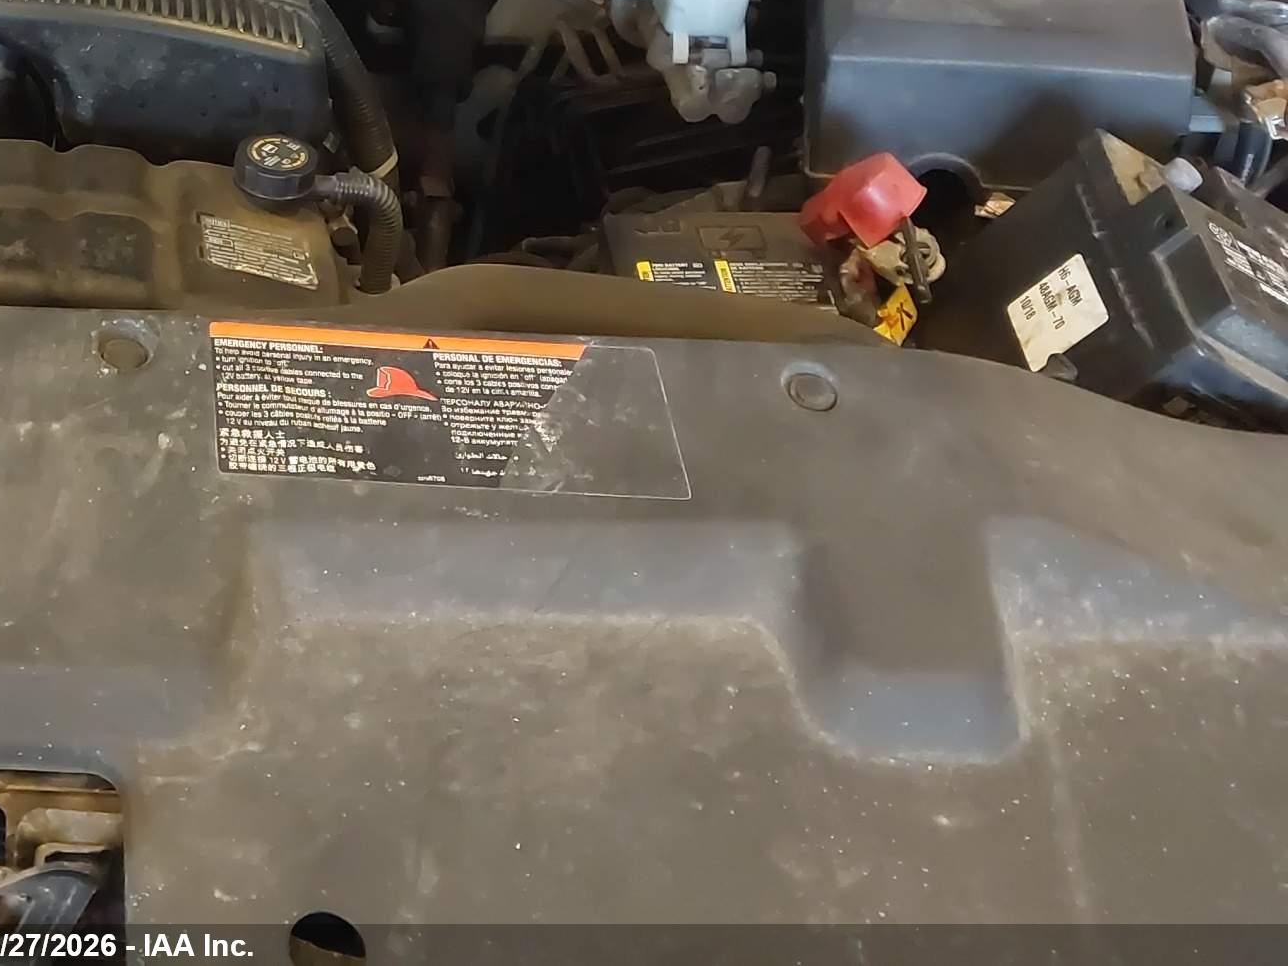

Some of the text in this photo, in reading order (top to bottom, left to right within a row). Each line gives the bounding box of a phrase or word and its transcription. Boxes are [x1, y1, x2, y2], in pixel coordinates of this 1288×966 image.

[1020, 296, 1036, 320] 10/18
[214, 339, 323, 353] EMERGENCY PERSONNEL:
[433, 353, 562, 367] PERSONAL DE EMERGENCIAS:
[434, 361, 451, 369] Para
[304, 369, 340, 378] connected
[217, 383, 269, 392] PERSONNEL
[271, 385, 283, 393] DE
[285, 386, 326, 397] SECOURS
[217, 392, 233, 400] Pour
[332, 400, 367, 409] blessures
[225, 400, 254, 409] Tourner
[398, 411, 412, 419] OFF
